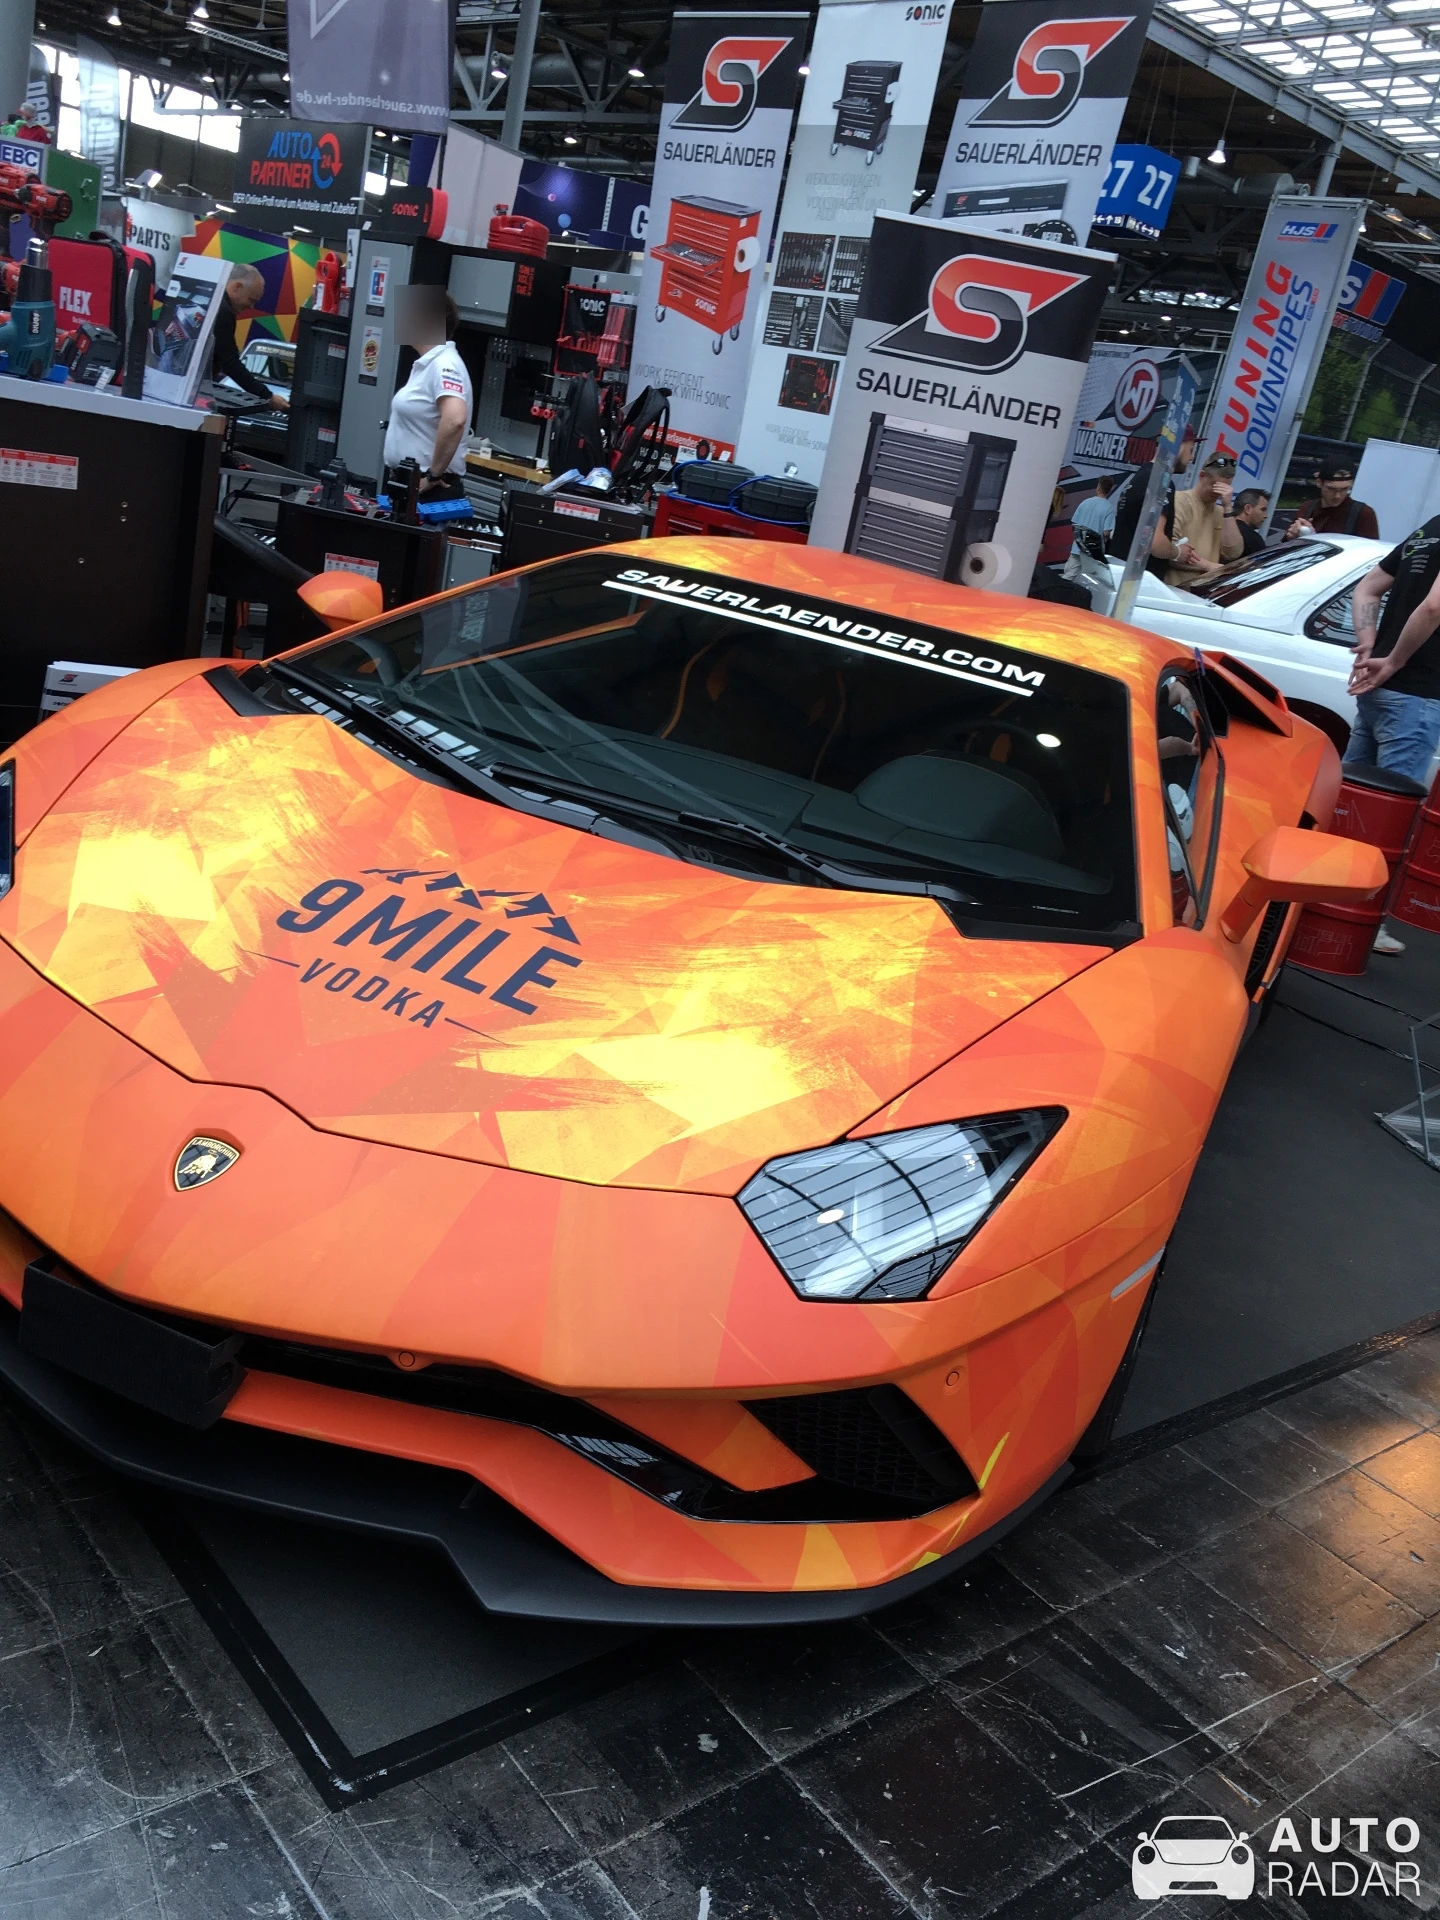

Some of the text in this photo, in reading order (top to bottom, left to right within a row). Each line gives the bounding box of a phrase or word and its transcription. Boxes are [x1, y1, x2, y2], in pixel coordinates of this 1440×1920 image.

[2, 146, 38, 167] EBC
[267, 131, 313, 159] AUTO
[663, 141, 777, 168] SAUERLÄNDER
[955, 138, 1103, 167] SAUERLÄNDER
[250, 160, 312, 190] PARTNER
[1137, 164, 1173, 210] 27
[131, 224, 170, 251] PARTS
[1282, 224, 1317, 236] HJS
[59, 286, 92, 316] FLEX
[1216, 260, 1293, 459] TUNING
[1239, 274, 1313, 479] DOWNPIPES
[856, 367, 1062, 429] SAUERLÄNDER
[1075, 430, 1128, 461] WAGNER
[616, 568, 1047, 687] SAUERLAENDER.COM
[332, 894, 584, 1016] MILE
[299, 957, 446, 1029] VODKA
[192, 1139, 237, 1160] LAMBORGHINI
